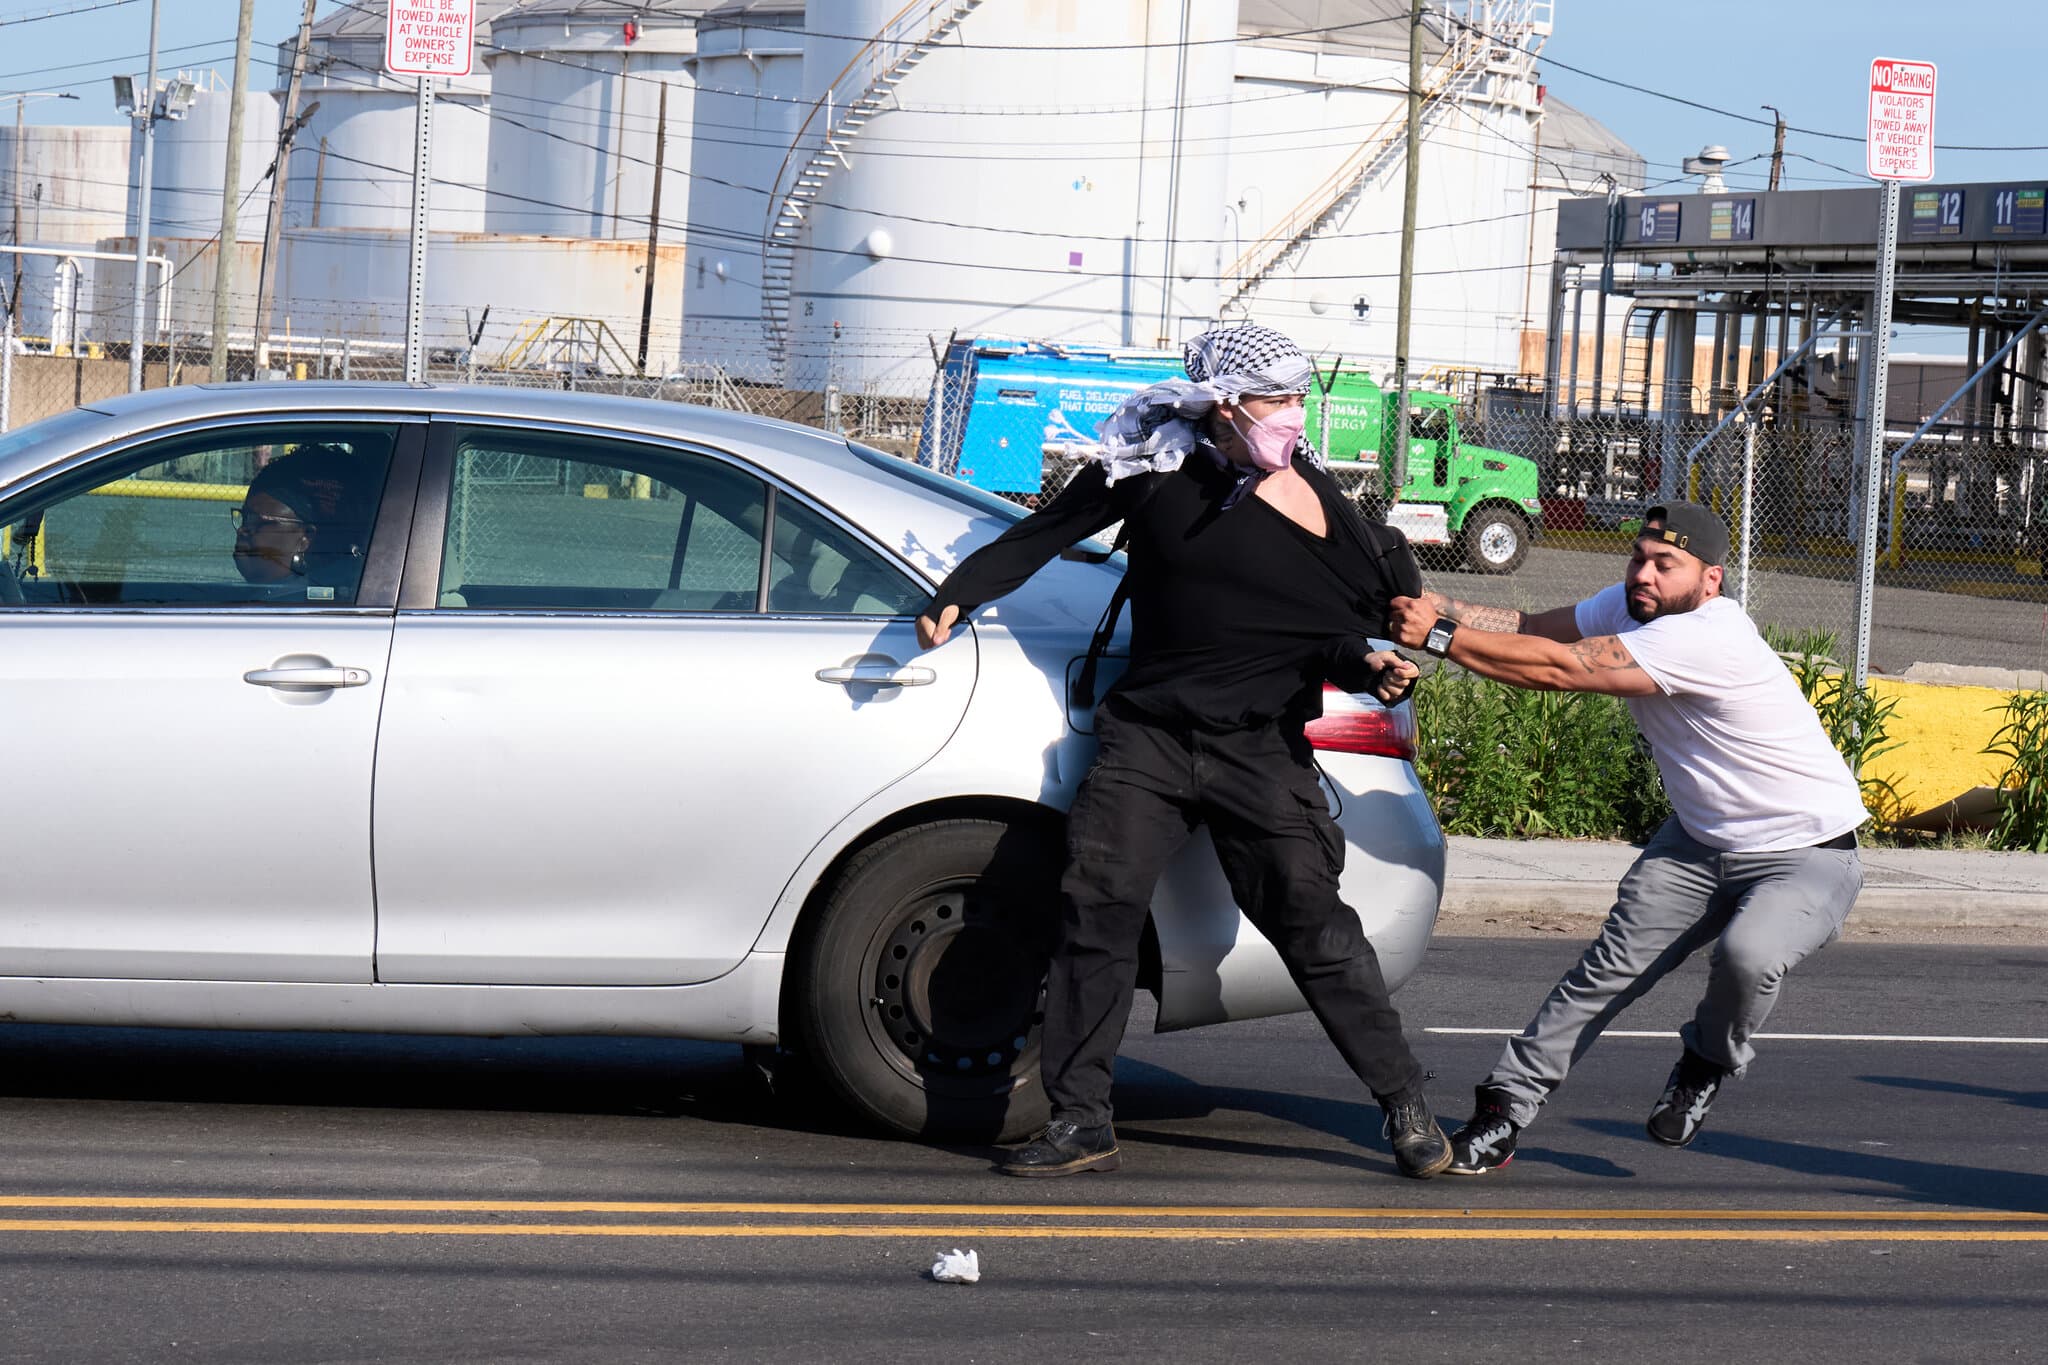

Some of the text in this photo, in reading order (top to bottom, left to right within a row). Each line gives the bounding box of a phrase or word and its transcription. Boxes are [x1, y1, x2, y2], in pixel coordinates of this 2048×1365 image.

[410, 0, 454, 10] WILL BE
[396, 9, 467, 24] TOWED AWAY
[399, 23, 463, 38] AT VEHICLE
[405, 37, 455, 51] OWNER'S
[405, 51, 454, 65] EXPENSE
[1873, 66, 1931, 89] NO PARKING
[1878, 94, 1924, 109] VIOLATORS
[1883, 107, 1917, 120] WILL BE
[1873, 119, 1928, 134] TOWED AWAY
[1874, 132, 1924, 146] AT VEHICLE
[1879, 145, 1918, 158] OWNER'S
[1879, 158, 1918, 170] EXPENSE
[1941, 192, 1960, 225] 12
[1996, 191, 2013, 225] 11
[1641, 207, 1656, 237] 15
[1735, 203, 1751, 235] 14
[1059, 389, 1083, 401] FUEL
[1060, 400, 1082, 412] THAT
[1085, 401, 1118, 413] DOESN
